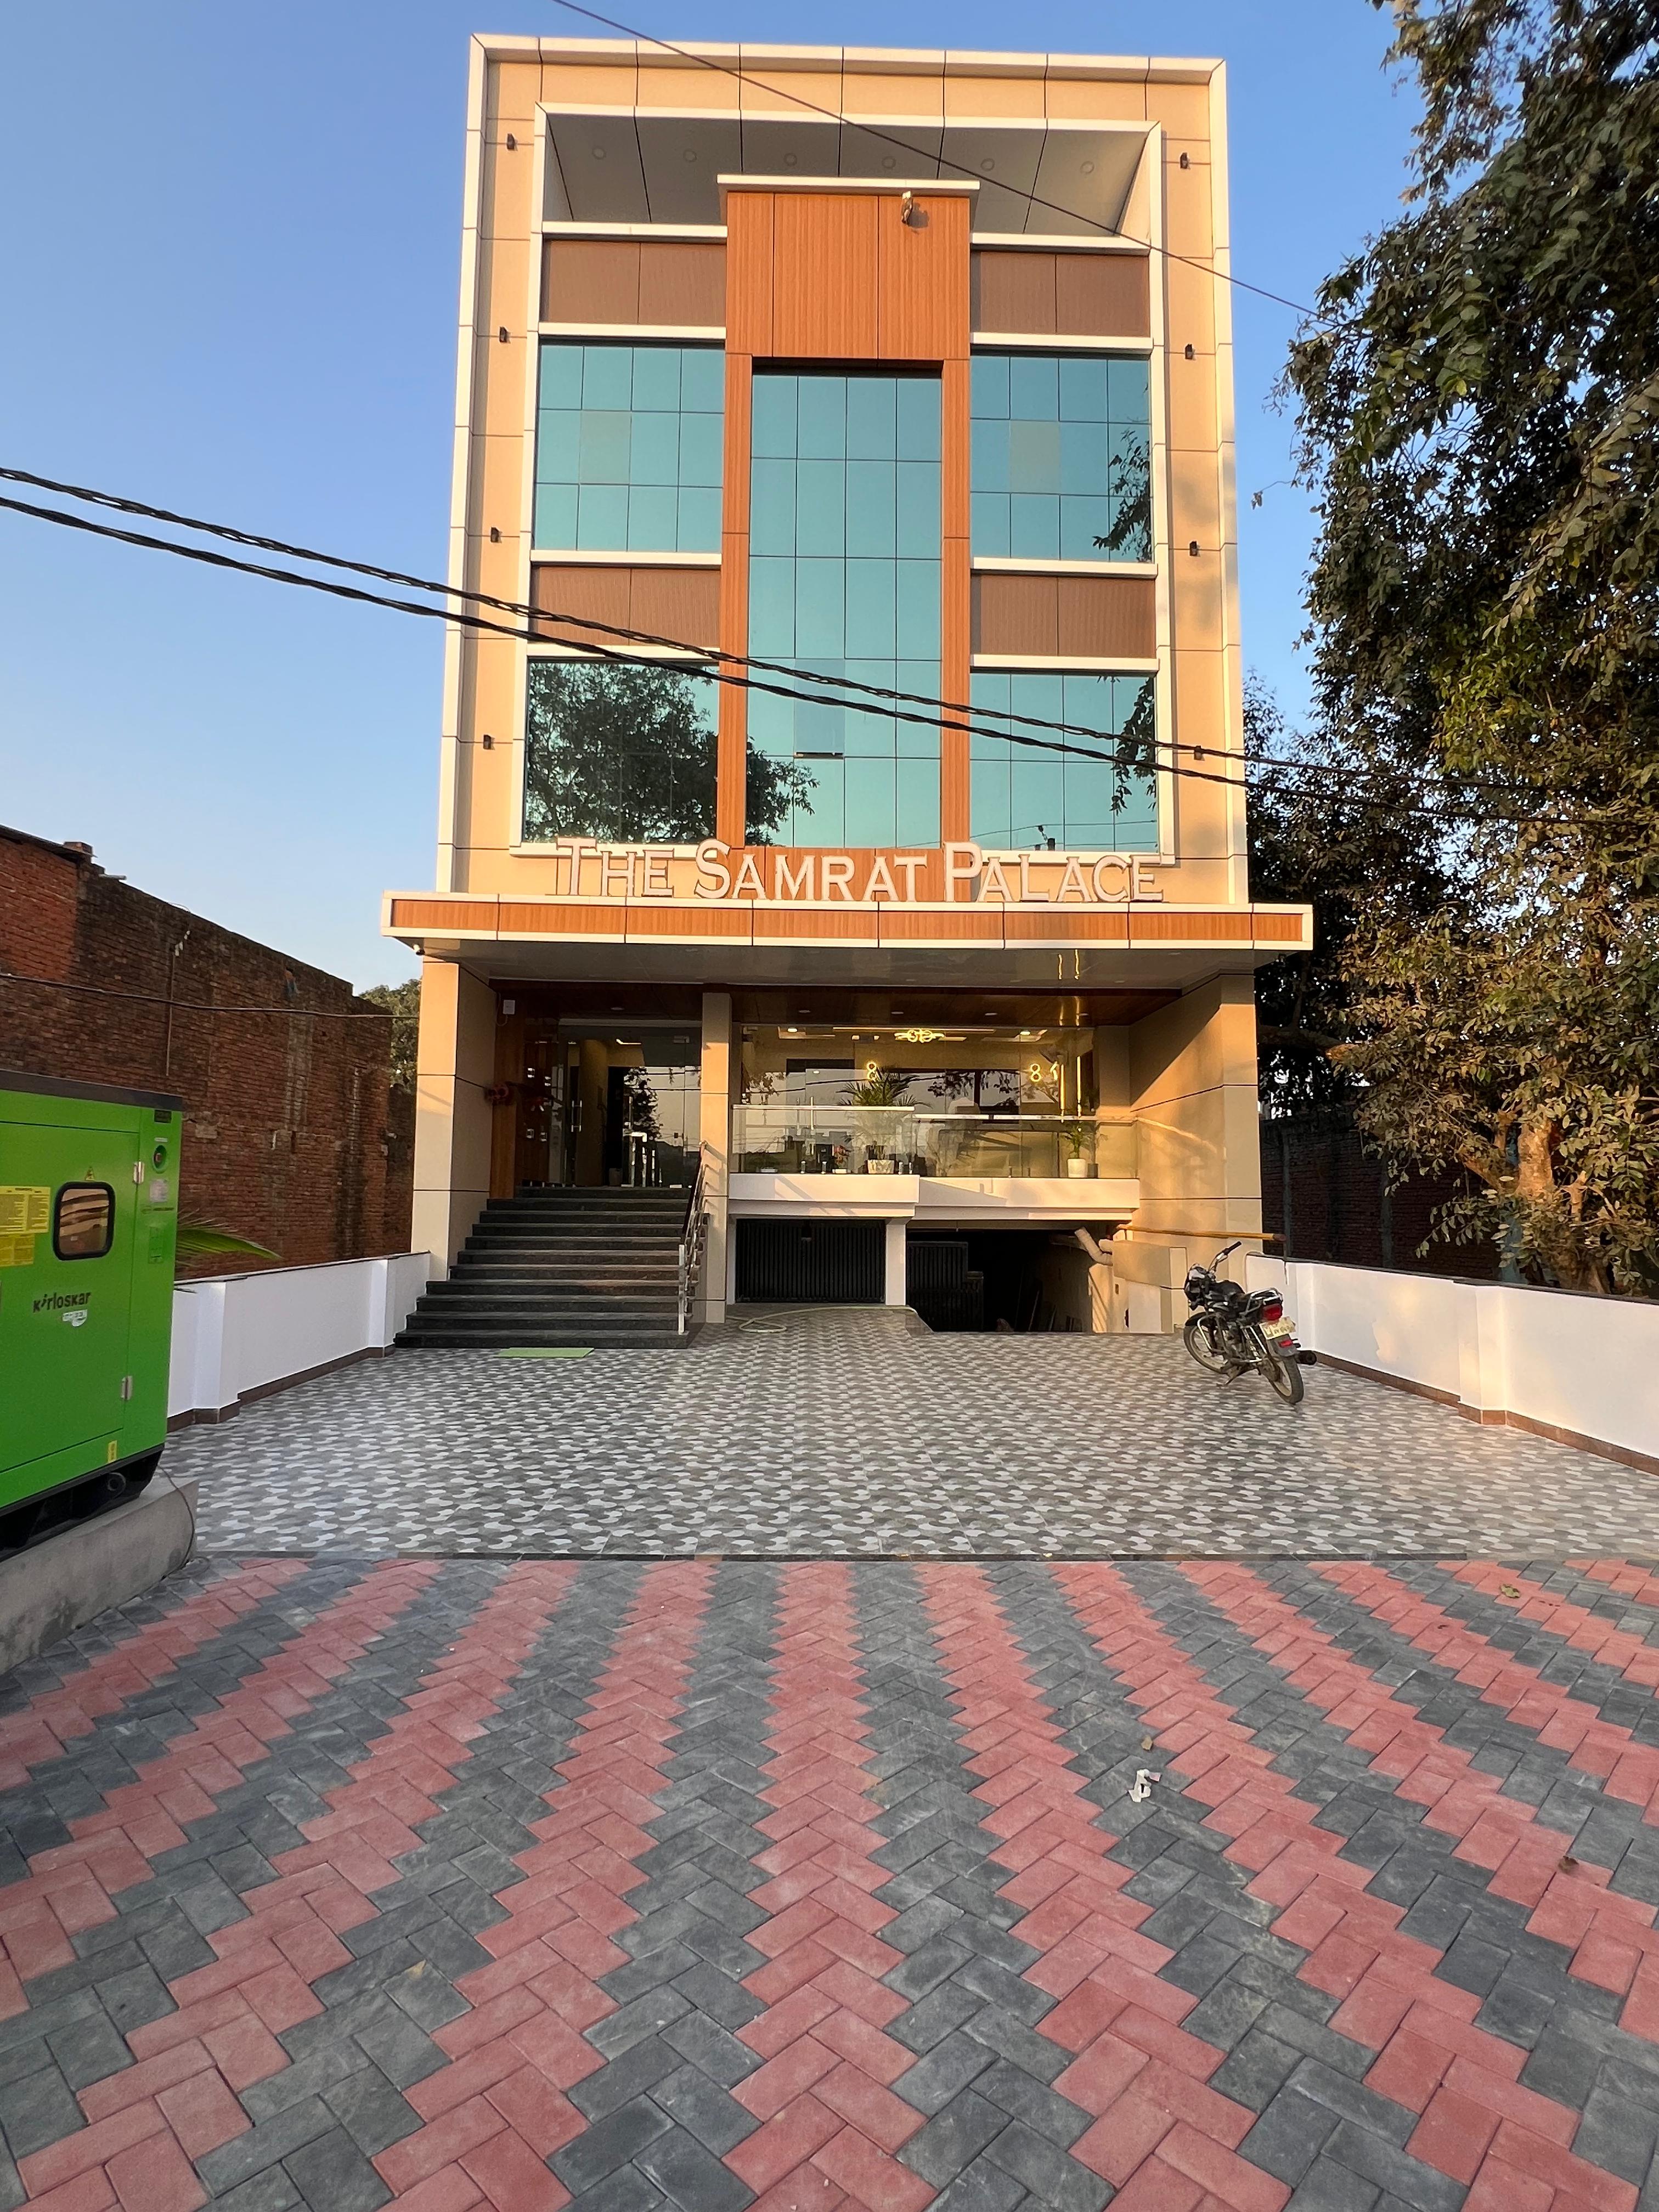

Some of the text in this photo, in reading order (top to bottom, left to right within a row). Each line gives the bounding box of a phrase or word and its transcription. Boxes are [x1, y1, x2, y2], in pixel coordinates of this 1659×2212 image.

[556, 837, 1164, 902] THE SAMRAT PALACE
